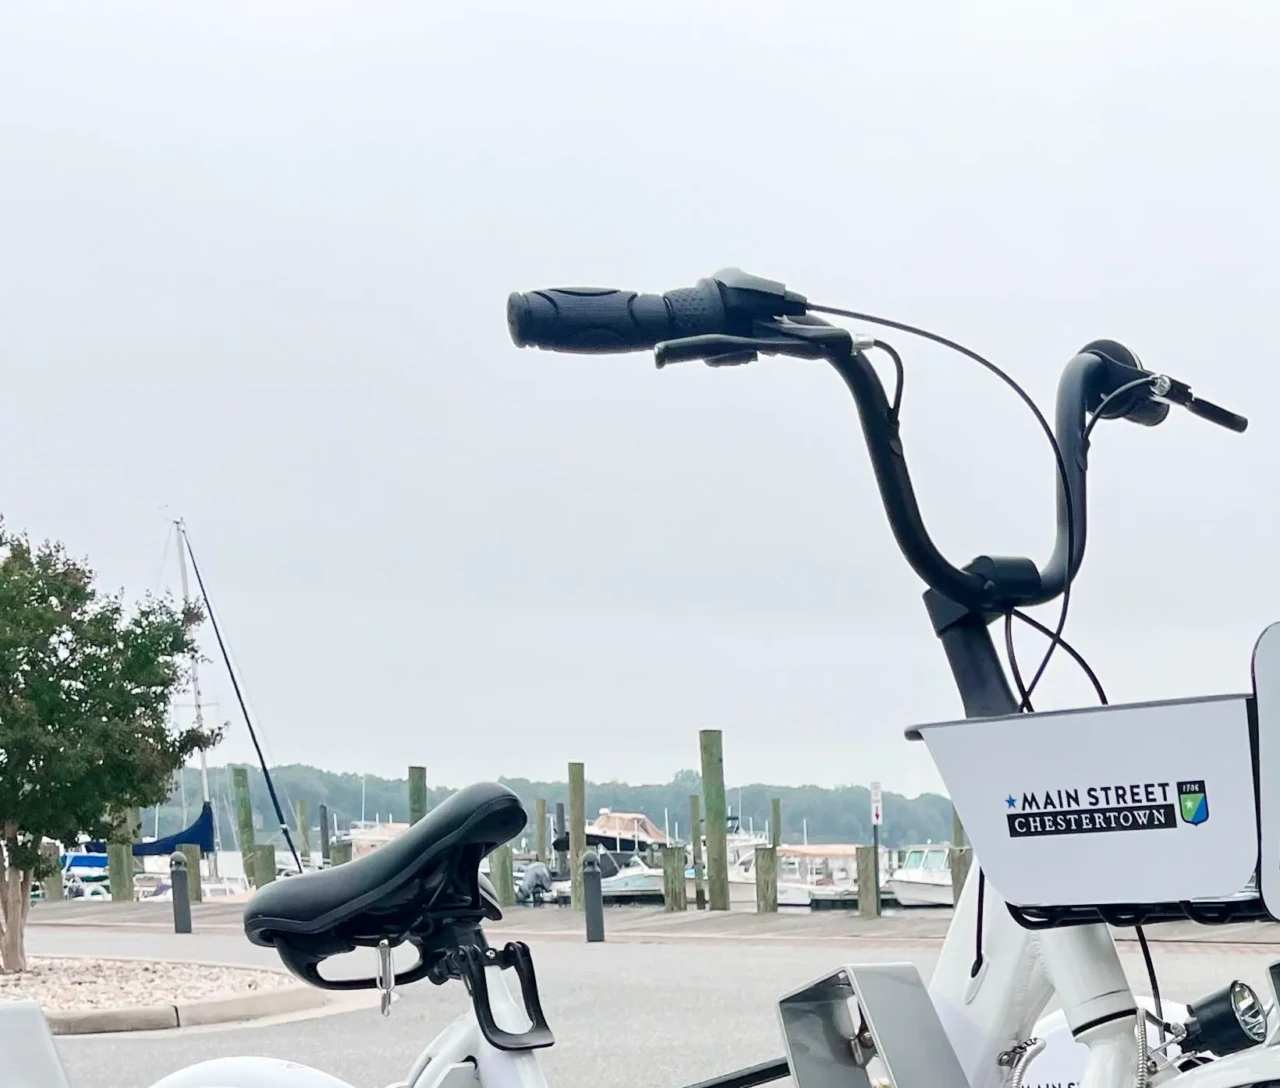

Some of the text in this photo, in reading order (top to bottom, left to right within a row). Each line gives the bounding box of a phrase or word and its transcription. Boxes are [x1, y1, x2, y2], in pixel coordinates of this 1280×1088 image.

[1021, 782, 1170, 811] MAIN STREET
[1014, 809, 1166, 833] CHESTERTOWN
